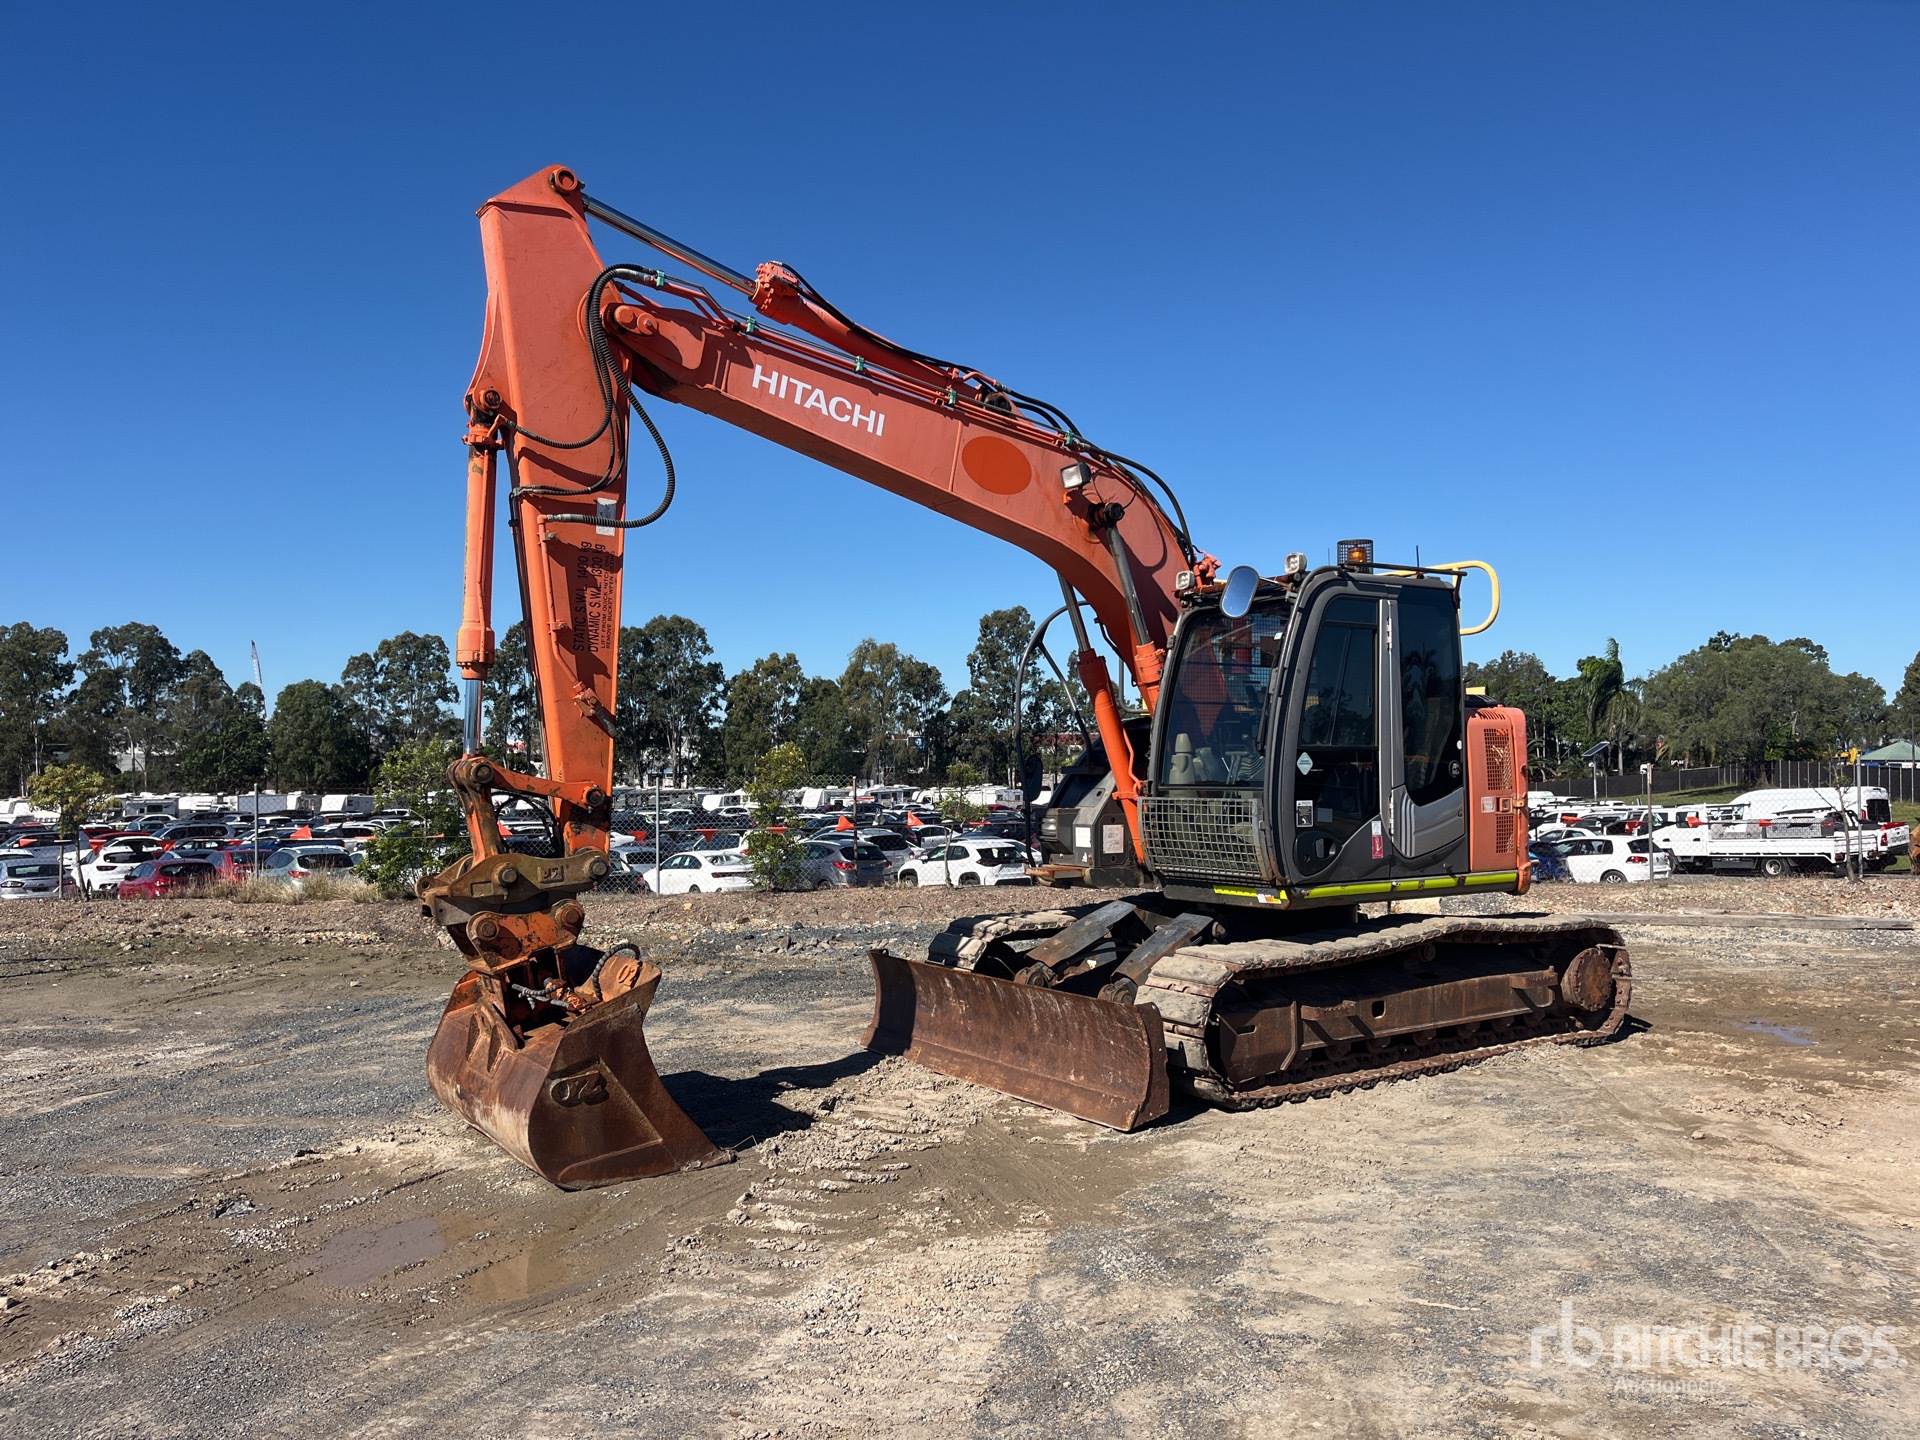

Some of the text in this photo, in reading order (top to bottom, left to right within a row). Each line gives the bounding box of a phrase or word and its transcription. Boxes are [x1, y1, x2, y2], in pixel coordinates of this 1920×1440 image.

[752, 364, 885, 437] HITACHI
[580, 541, 592, 553] kg
[594, 543, 606, 554] kg
[578, 555, 589, 579] 1400
[592, 556, 602, 577] 1300
[574, 616, 586, 651] STATIC
[588, 611, 600, 652] DYNAMIC
